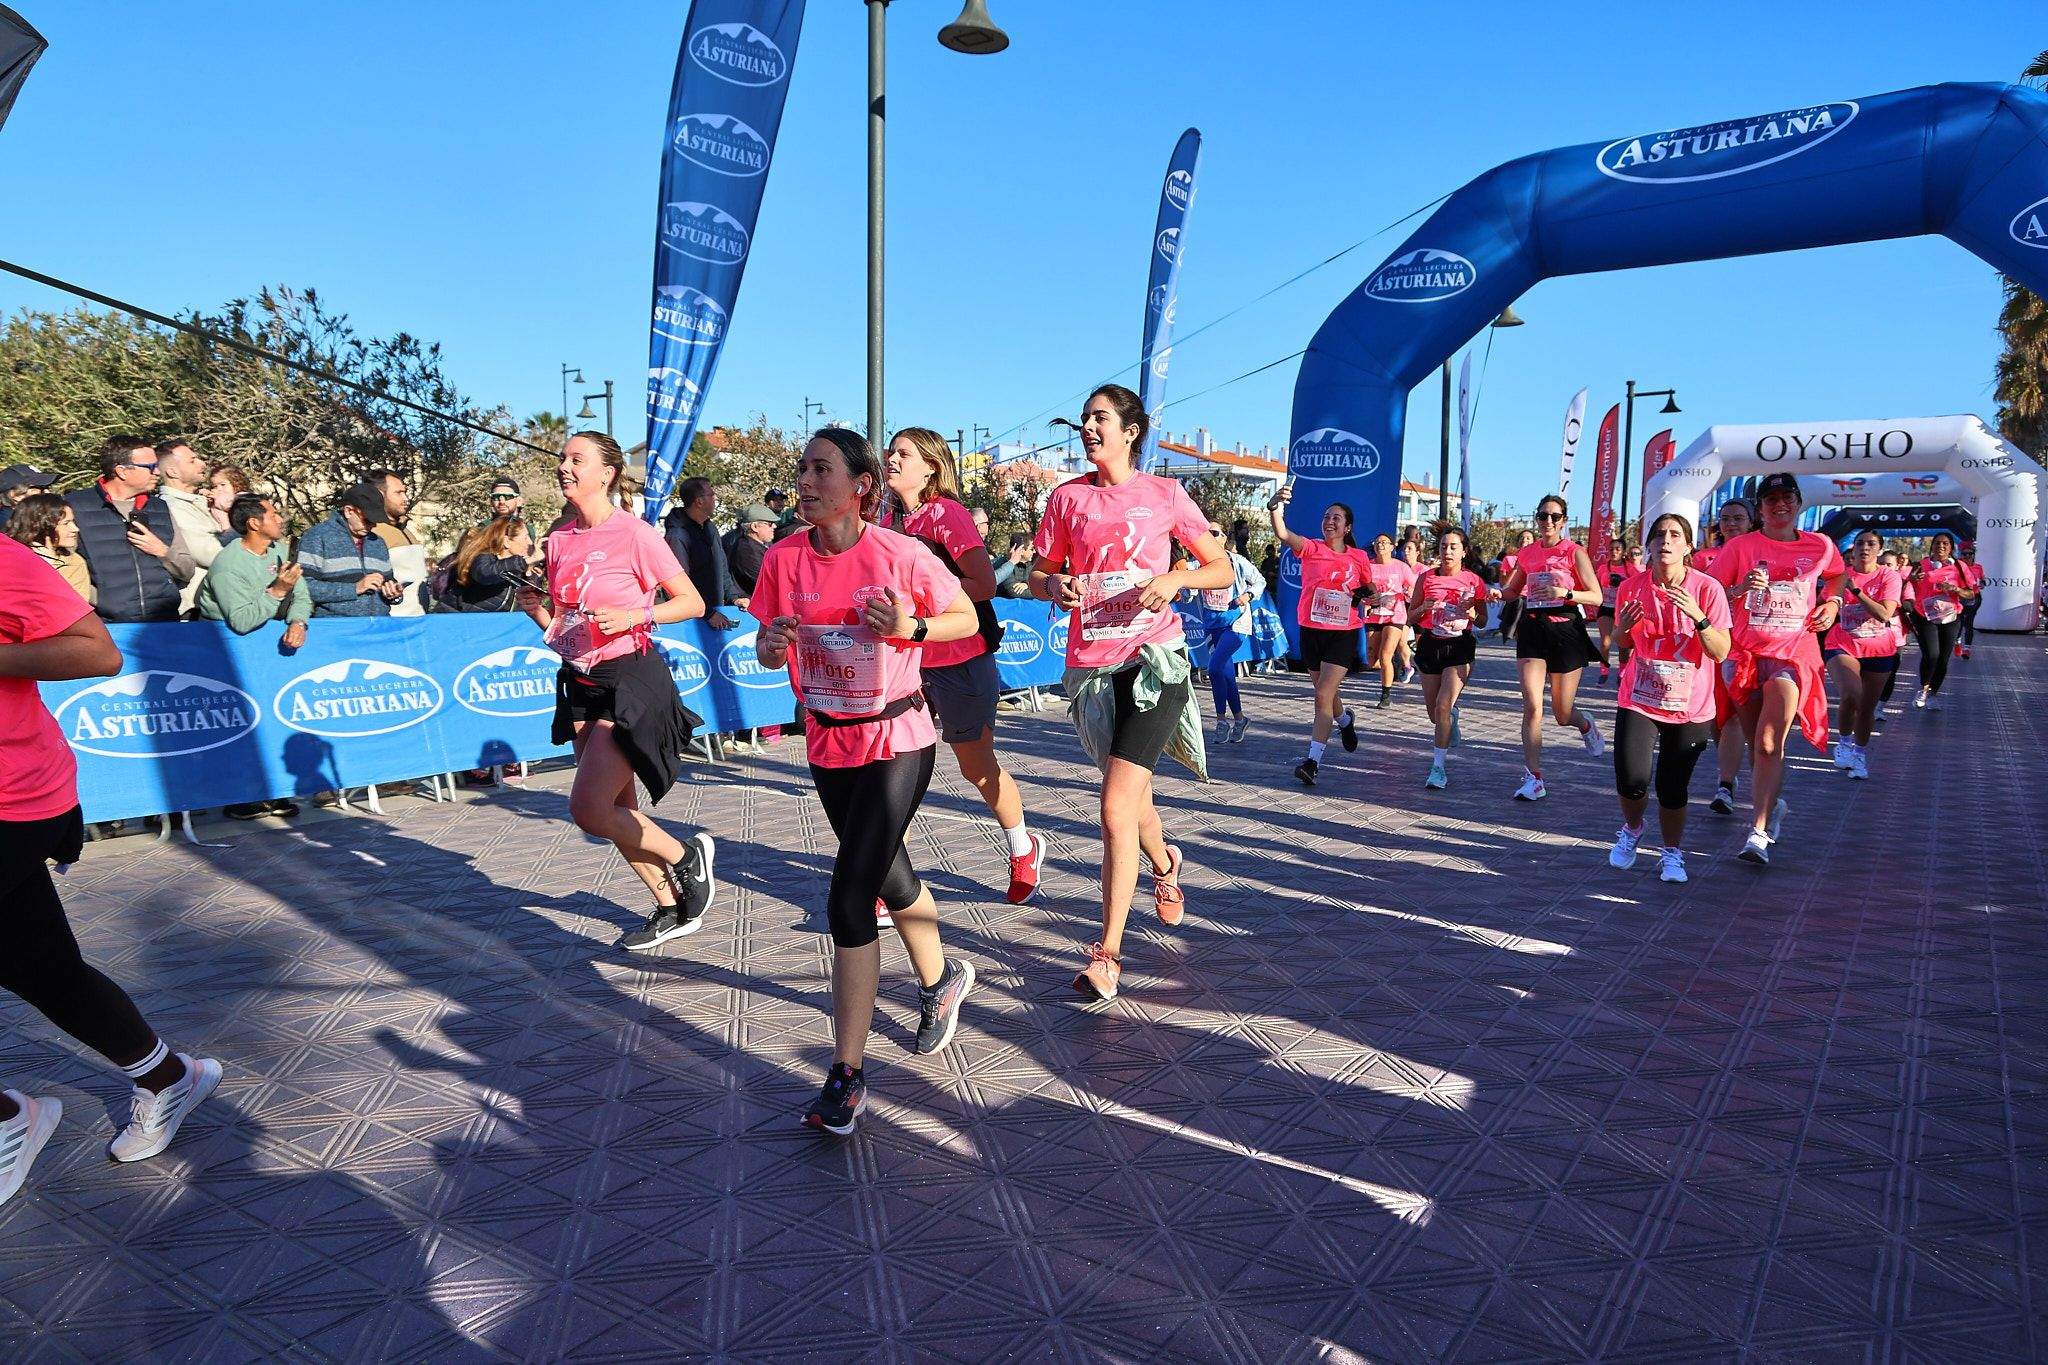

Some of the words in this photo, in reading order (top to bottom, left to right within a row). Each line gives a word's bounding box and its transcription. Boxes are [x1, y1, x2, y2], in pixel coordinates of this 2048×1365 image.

[694, 35, 777, 78] ASTURIANA
[674, 123, 762, 169] ASTURIANA
[1611, 110, 1836, 170] ASTURIANA
[1370, 271, 1467, 293] ASTURIANA
[1756, 430, 1914, 462] OYSHO
[1291, 449, 1372, 469] ASTURIANA
[1653, 449, 1664, 470] der
[1959, 457, 2015, 469] OYSHO
[1669, 468, 1711, 477] OYSHO
[1985, 518, 2037, 529] OYSHO
[1982, 577, 2031, 588] OYSHO
[1104, 600, 1132, 613] 016
[483, 669, 527, 680] CENTRAL
[825, 664, 856, 680] 016
[311, 685, 367, 697] CENTRAL
[370, 680, 425, 692] LECHERA
[101, 700, 167, 713] CENTRAL
[174, 694, 238, 708] LECHERA
[289, 690, 434, 722] ASTURIANA
[808, 697, 833, 707] OYSHO
[71, 706, 250, 741] ASTURIANA
